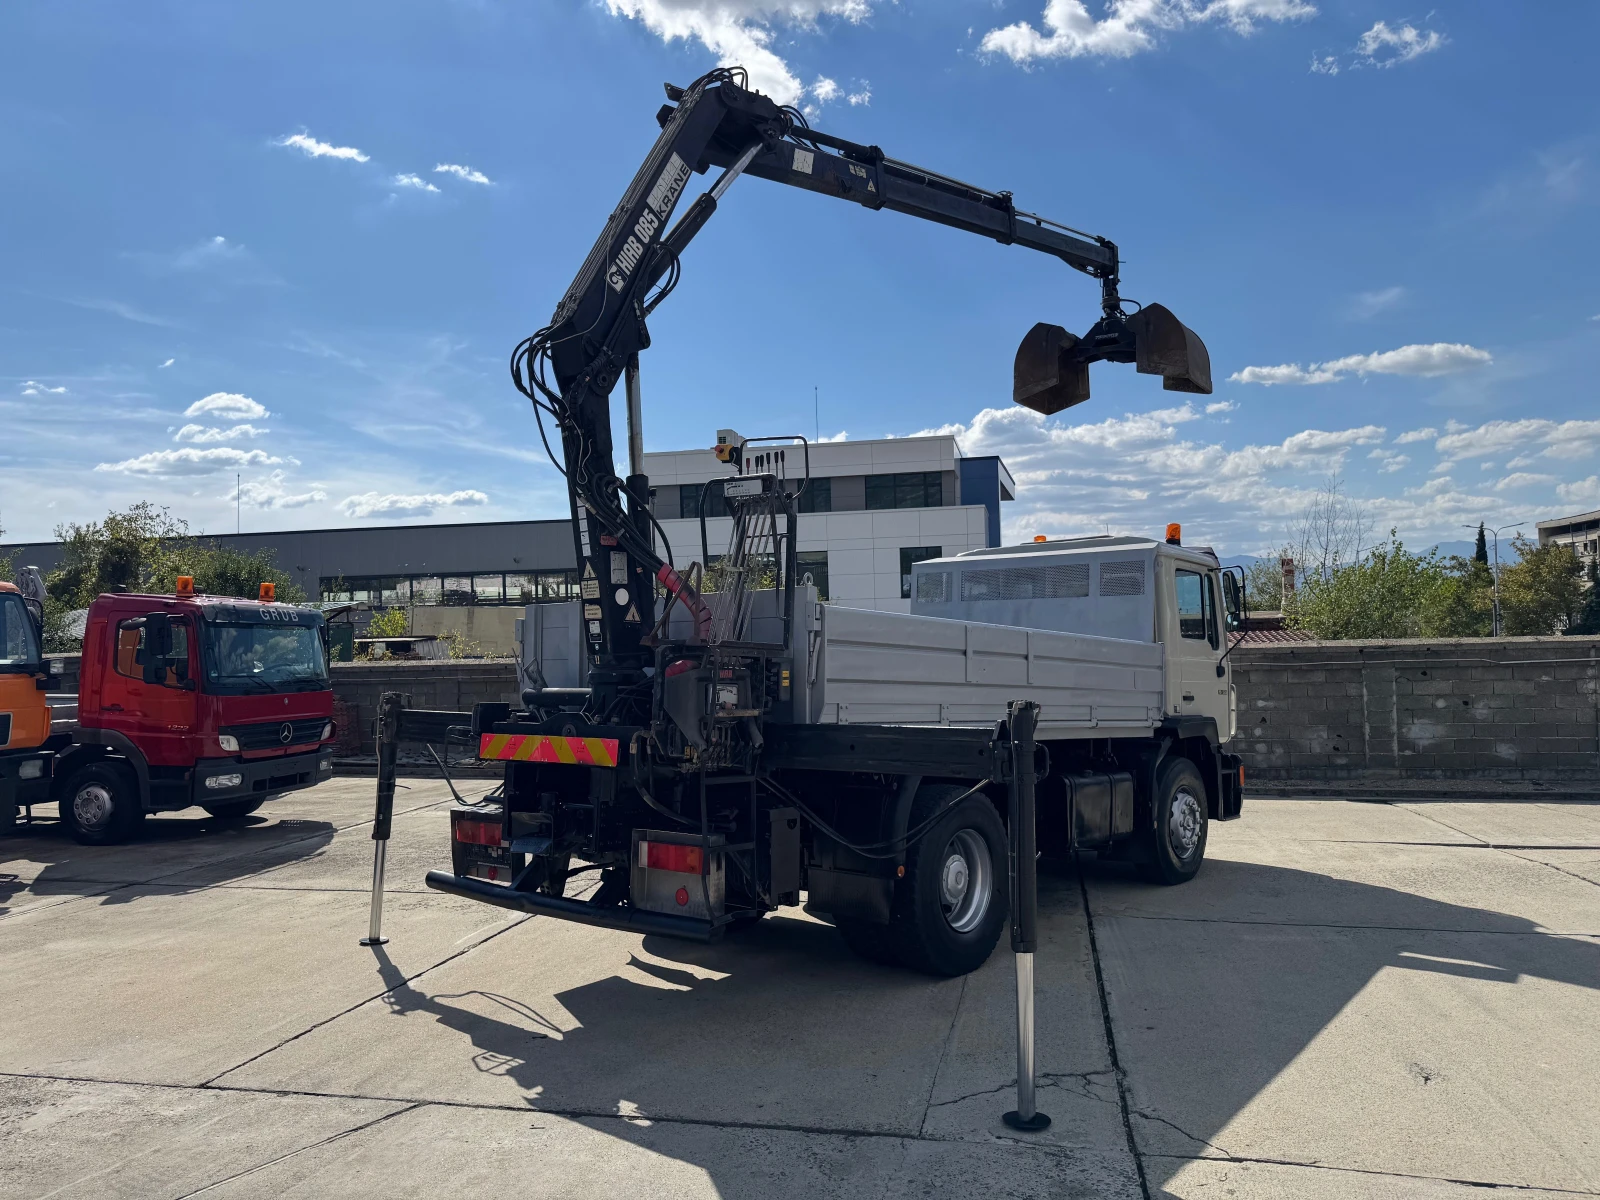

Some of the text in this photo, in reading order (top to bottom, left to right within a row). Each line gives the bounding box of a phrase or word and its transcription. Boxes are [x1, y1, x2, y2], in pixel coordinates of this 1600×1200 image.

[656, 163, 690, 218] KRÄNE
[616, 208, 659, 275] HIAB 085
[260, 608, 299, 622] GRUB
